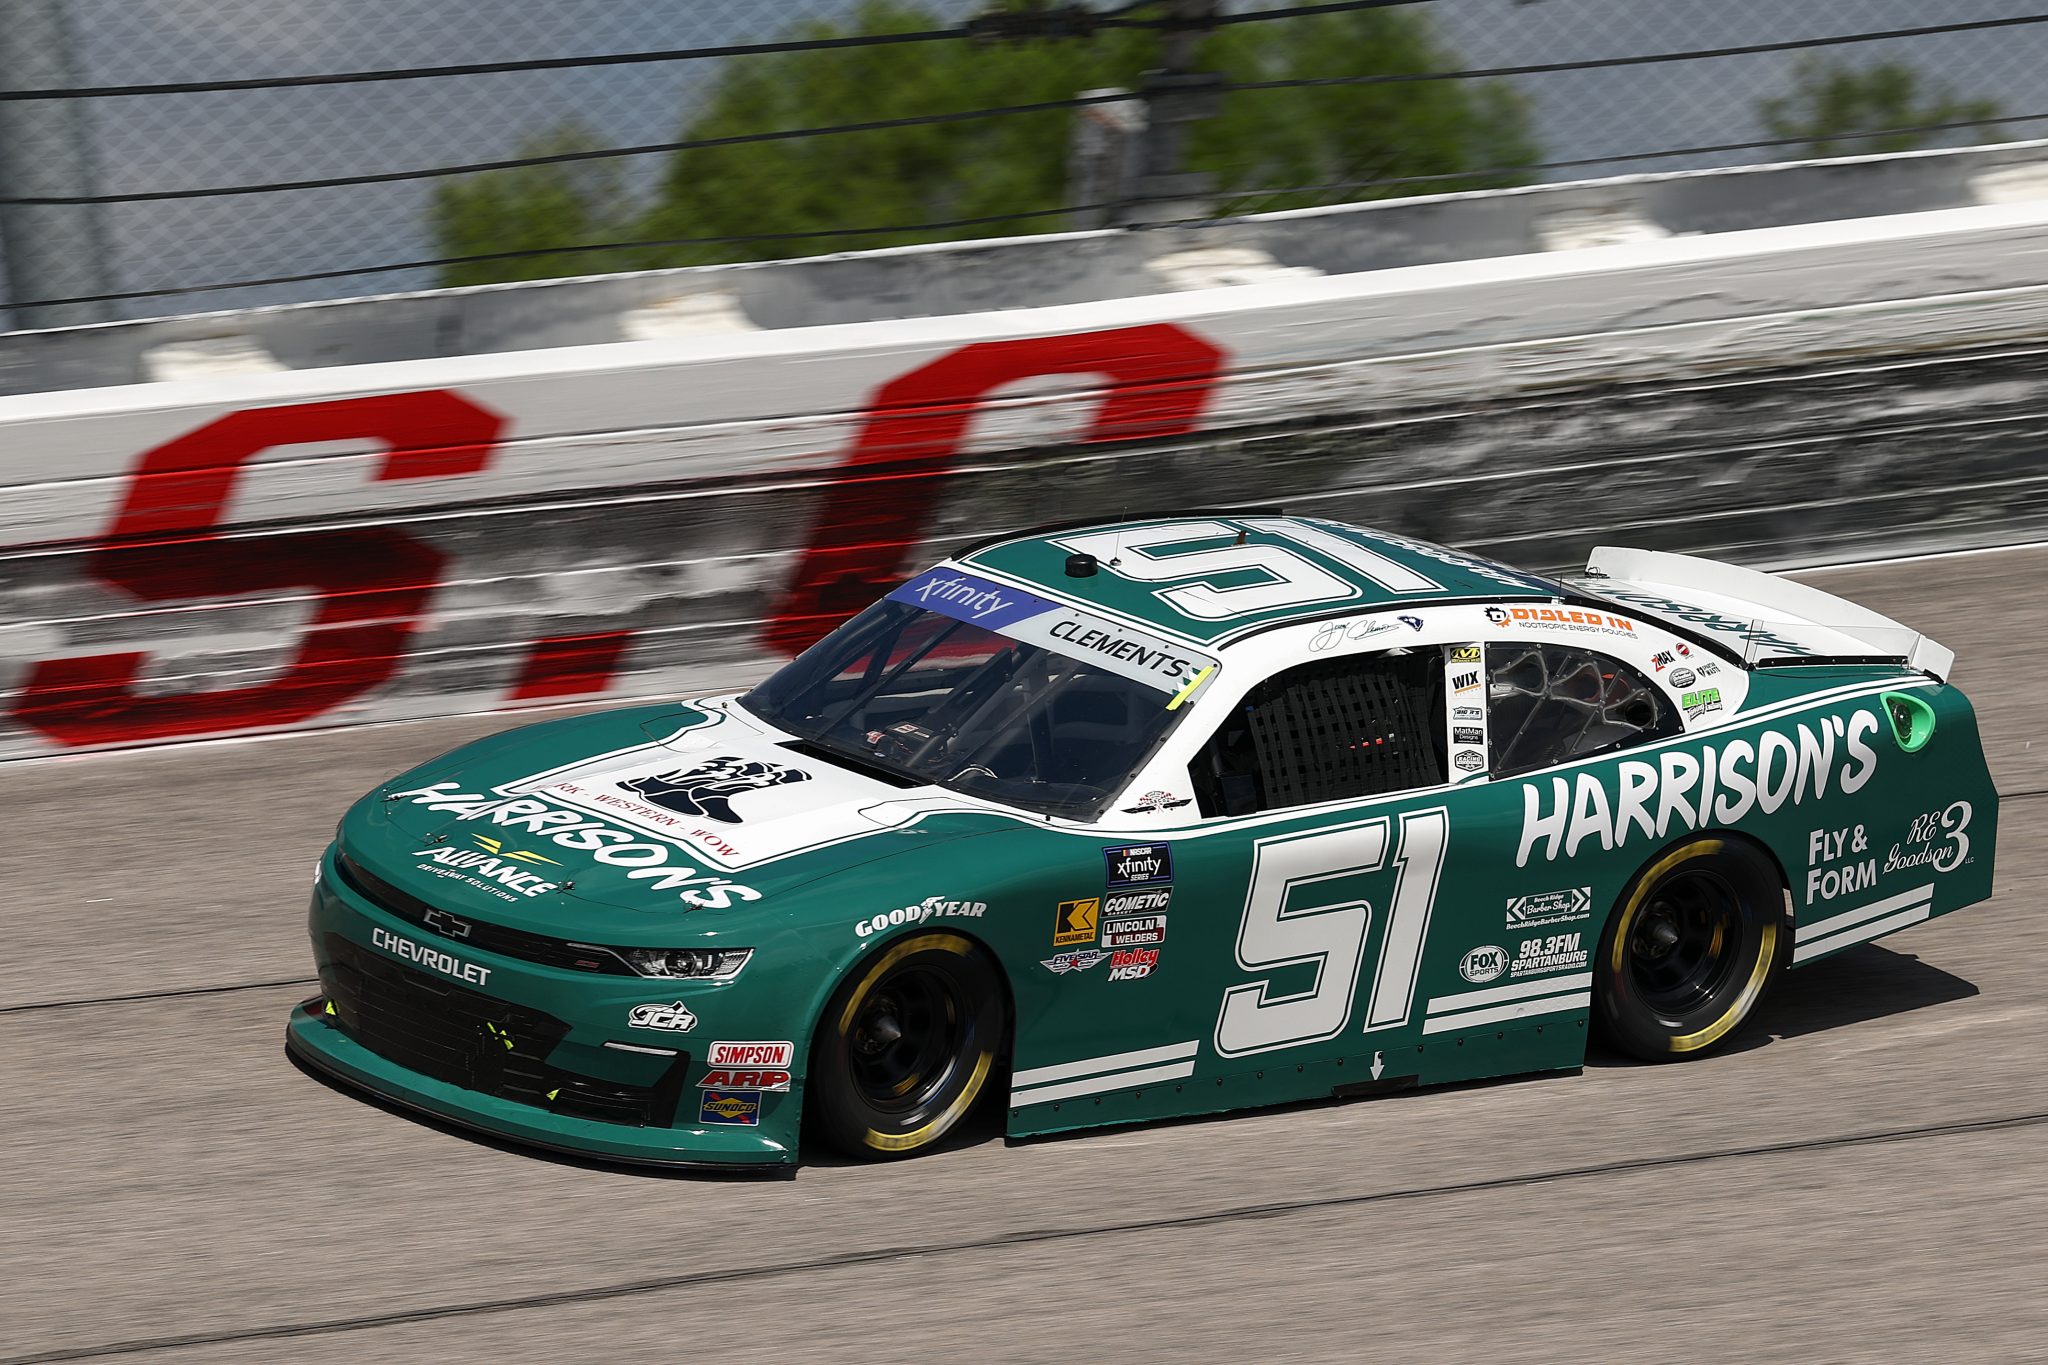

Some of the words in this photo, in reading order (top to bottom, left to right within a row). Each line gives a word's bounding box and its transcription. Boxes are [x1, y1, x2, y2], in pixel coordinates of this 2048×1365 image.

[1044, 518, 1449, 622] 51
[915, 577, 1014, 619] xfinity
[1518, 622, 1568, 631] NOOTROPIC
[1569, 624, 1600, 633] ENERGY
[1602, 628, 1639, 639] POUCHES
[1607, 616, 1633, 631] IN
[1049, 621, 1191, 678] CLEMENTS
[1452, 670, 1479, 690] WIX
[1681, 688, 1721, 710] ELITE
[1454, 727, 1483, 737] MatMan
[1515, 709, 1879, 868] HARRISON'S
[594, 794, 680, 826] WESTERN
[690, 829, 740, 857] WOW
[391, 782, 762, 909] HARRISON'S
[1808, 827, 1849, 866] FLY
[1851, 824, 1868, 853] &
[1932, 800, 1973, 873] 3
[1129, 847, 1152, 856] NASCAR
[1882, 842, 1953, 875] Goodson
[1117, 857, 1161, 878] xfinity
[1130, 873, 1149, 881] SERIES
[465, 877, 518, 902] SOLUTIONS
[1806, 858, 1877, 905] FORM
[1104, 892, 1169, 913] COMETIC
[1527, 902, 1552, 914] Barber
[1552, 900, 1571, 912] Shop
[1534, 895, 1549, 903] Beech
[1106, 918, 1154, 934] LINCOLN
[1213, 805, 1450, 1059] 51
[1055, 931, 1094, 944] KENNAMETAL
[1116, 932, 1158, 944] WELDERS
[1519, 932, 1581, 959] 98.3FM
[372, 927, 491, 986] CHEVROLET
[1111, 948, 1160, 967] Holley
[1470, 951, 1498, 970] FOX
[1511, 950, 1587, 971] SPARTANBURG
[1108, 964, 1151, 981] MSD
[1469, 966, 1499, 976] SPORTS
[715, 1046, 785, 1064] SIMPSON
[702, 1071, 790, 1088] ARP
[704, 1102, 756, 1112] SUNOCO
